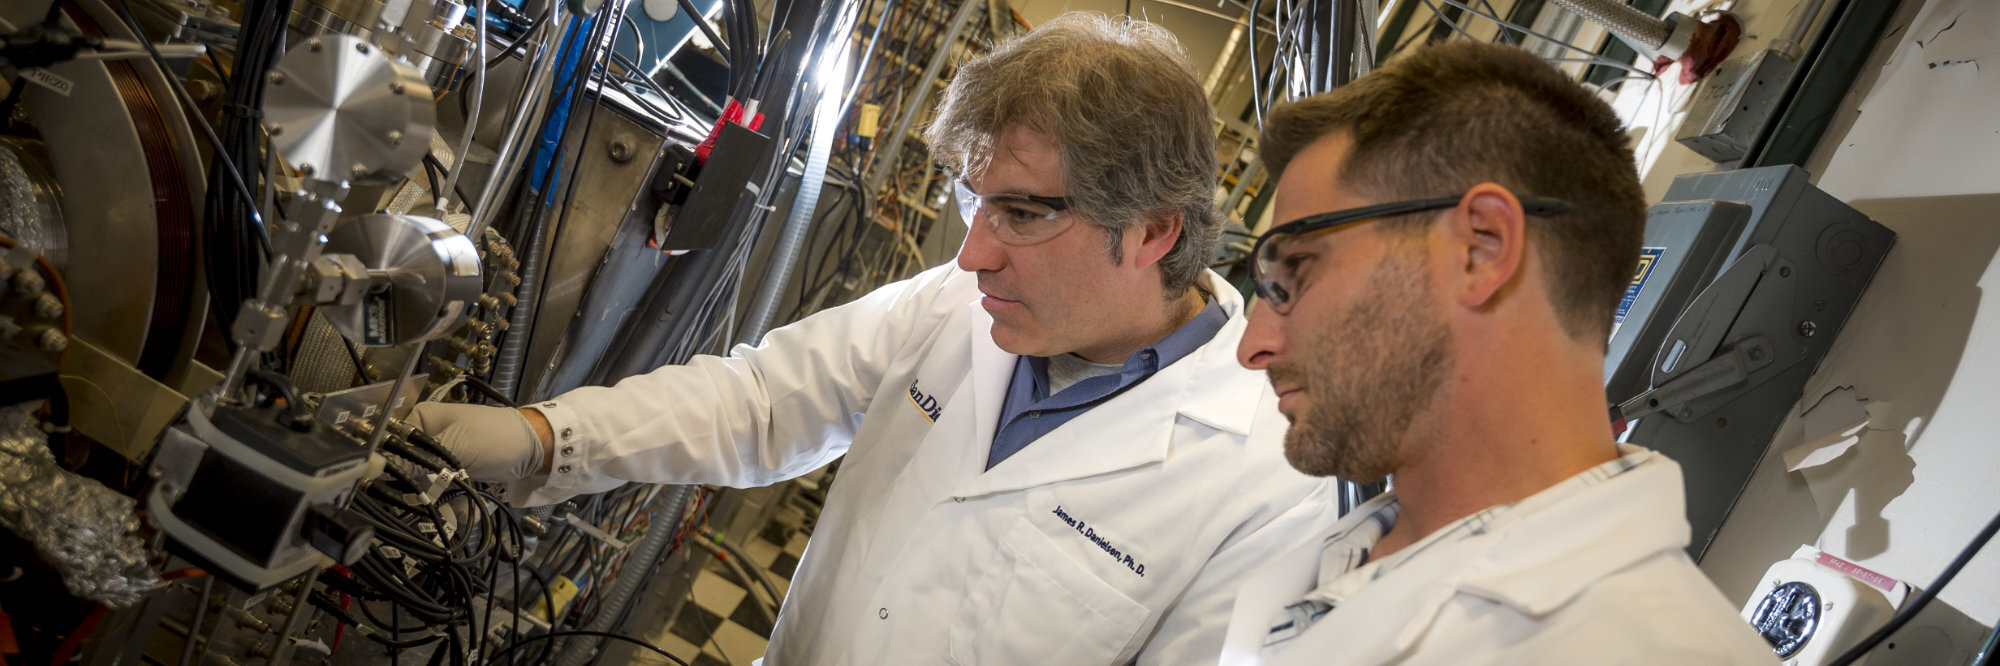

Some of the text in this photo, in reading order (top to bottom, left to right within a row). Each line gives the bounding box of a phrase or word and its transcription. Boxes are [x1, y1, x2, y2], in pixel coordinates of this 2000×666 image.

[32, 69, 69, 91] PIEZO
[1052, 505, 1145, 578] James R. Danielson, Ph. D.
